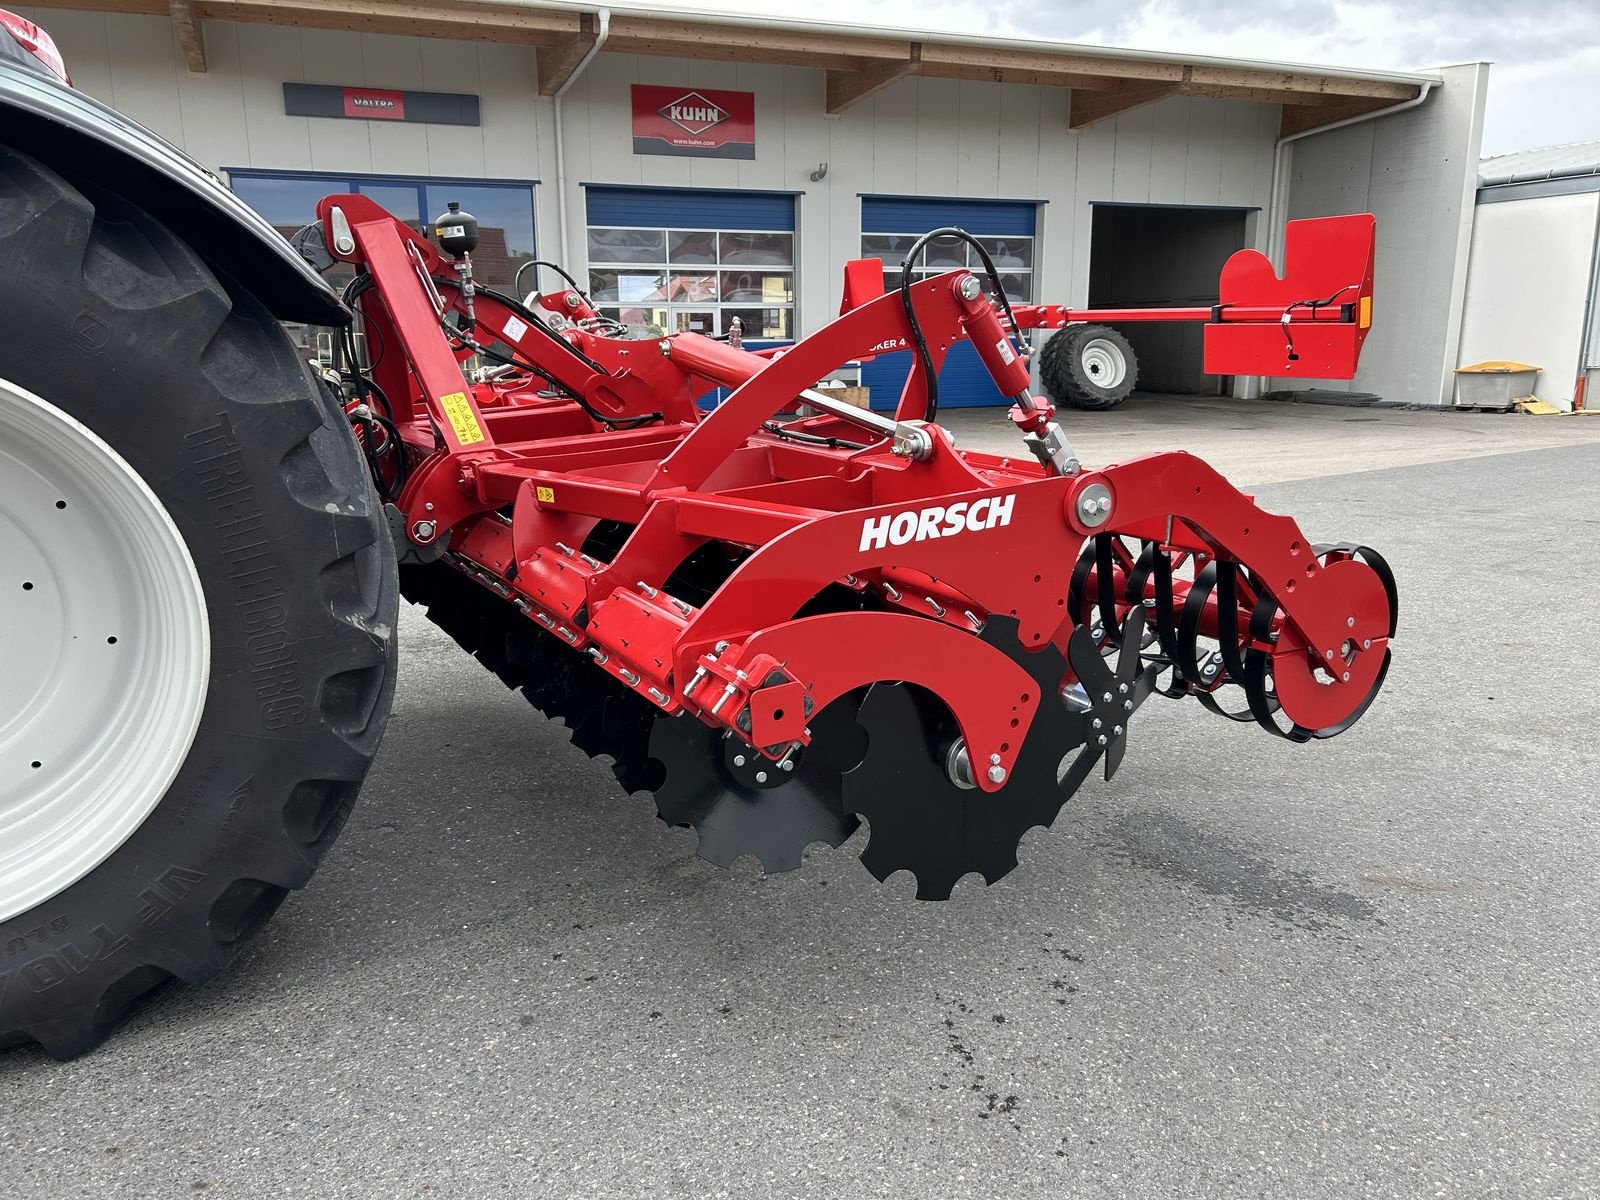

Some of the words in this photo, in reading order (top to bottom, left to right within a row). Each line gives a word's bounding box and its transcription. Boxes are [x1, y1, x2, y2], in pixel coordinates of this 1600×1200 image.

[671, 106, 719, 121] KUHN
[673, 139, 716, 147] www.kuhn.com
[898, 337, 906, 346] 4
[858, 494, 1016, 552] HORSCH
[183, 411, 307, 731] TRELLEBORG
[136, 865, 208, 926] VF
